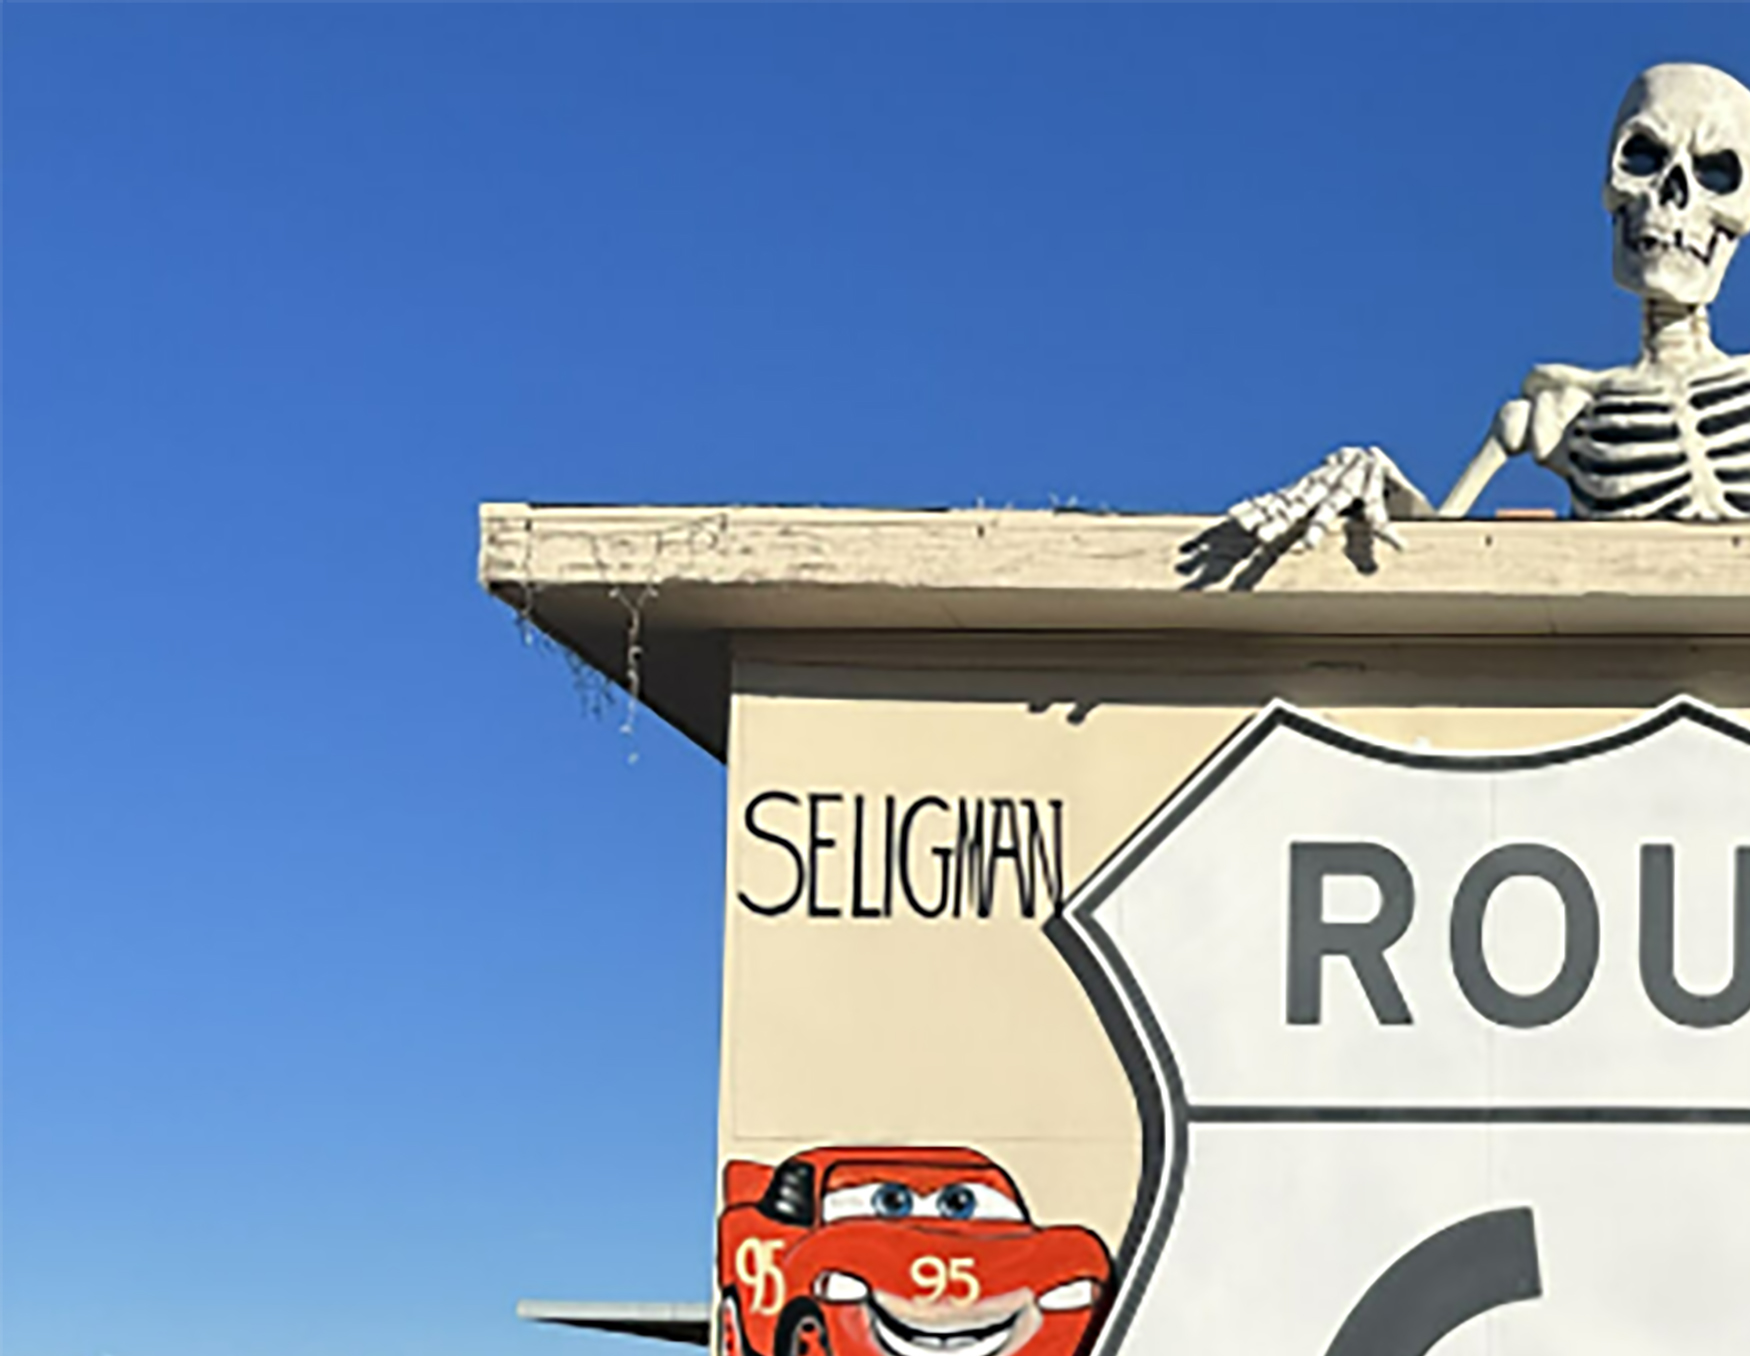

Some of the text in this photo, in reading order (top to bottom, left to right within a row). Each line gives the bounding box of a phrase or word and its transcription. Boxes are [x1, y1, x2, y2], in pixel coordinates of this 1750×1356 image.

[737, 790, 1064, 918] SELIGMAN
[735, 1238, 786, 1316] 95
[910, 1256, 981, 1304] 95
